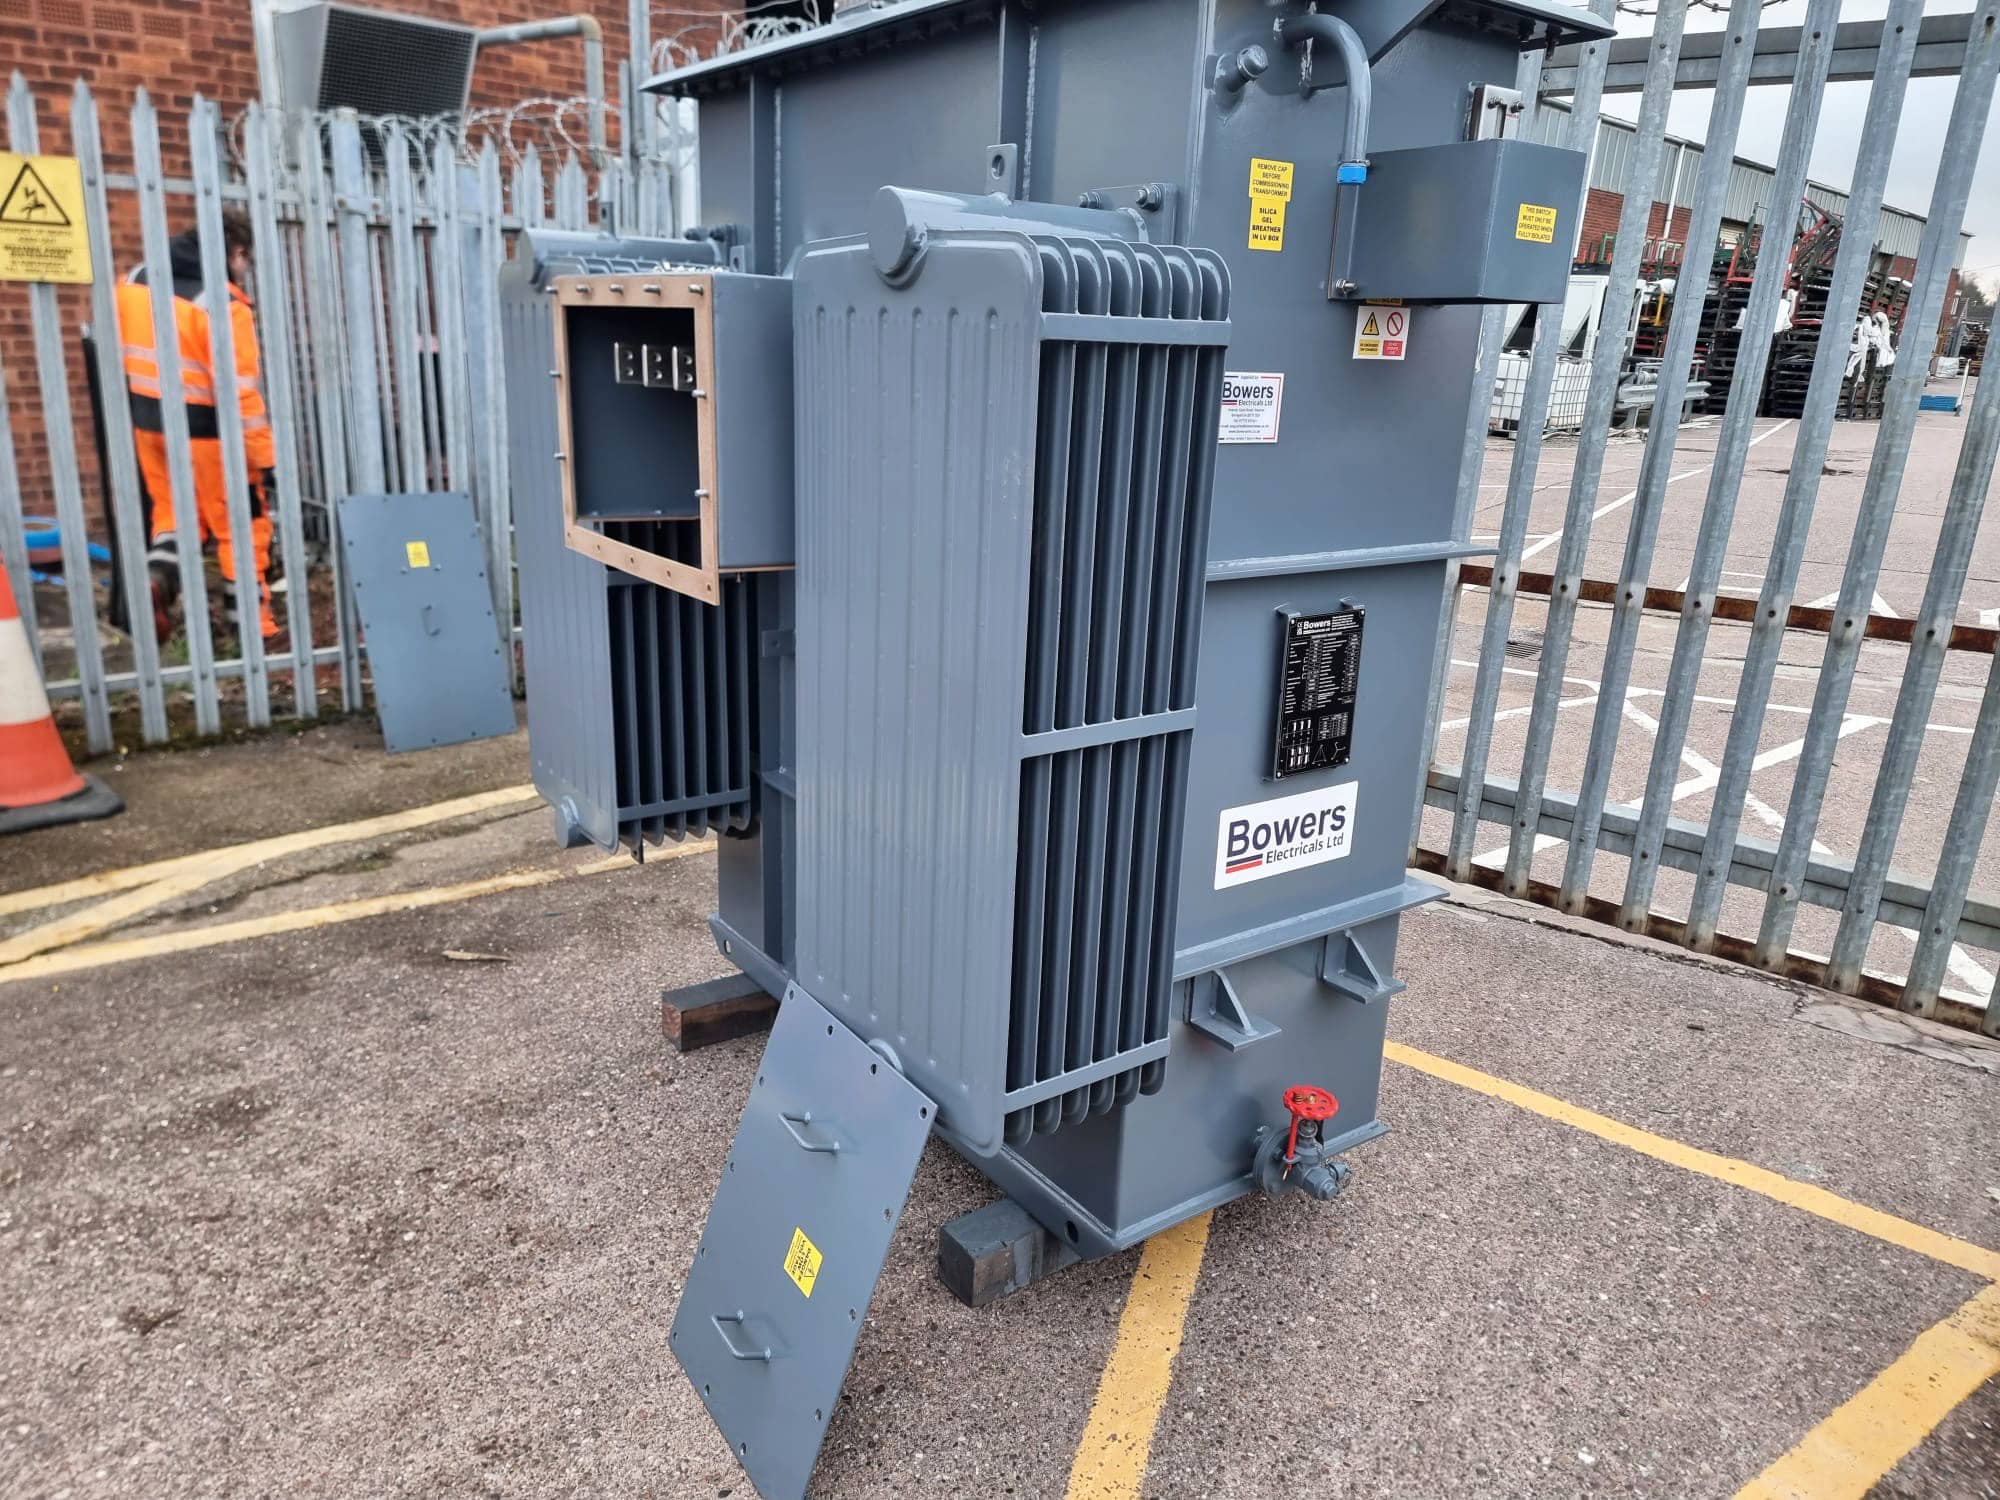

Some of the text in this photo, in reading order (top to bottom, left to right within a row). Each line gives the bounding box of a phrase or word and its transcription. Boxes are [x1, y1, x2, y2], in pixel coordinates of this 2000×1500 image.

[1257, 163, 1276, 171] REMOVE
[1262, 172, 1281, 180] BEFORE
[1252, 179, 1290, 189] COMMISSIONING
[1253, 187, 1288, 197] TRANSFORMER
[1259, 207, 1277, 215] SILICA
[1261, 216, 1273, 224] GEL
[1252, 224, 1281, 233] BREATHER
[1268, 234, 1280, 242] BOX
[1222, 381, 1274, 399] Bowers
[1238, 399, 1273, 407] Electricals Ltd
[1303, 620, 1331, 629] Bowers
[1227, 805, 1347, 858] Bowers
[1266, 833, 1344, 864] Electricals Ltd
